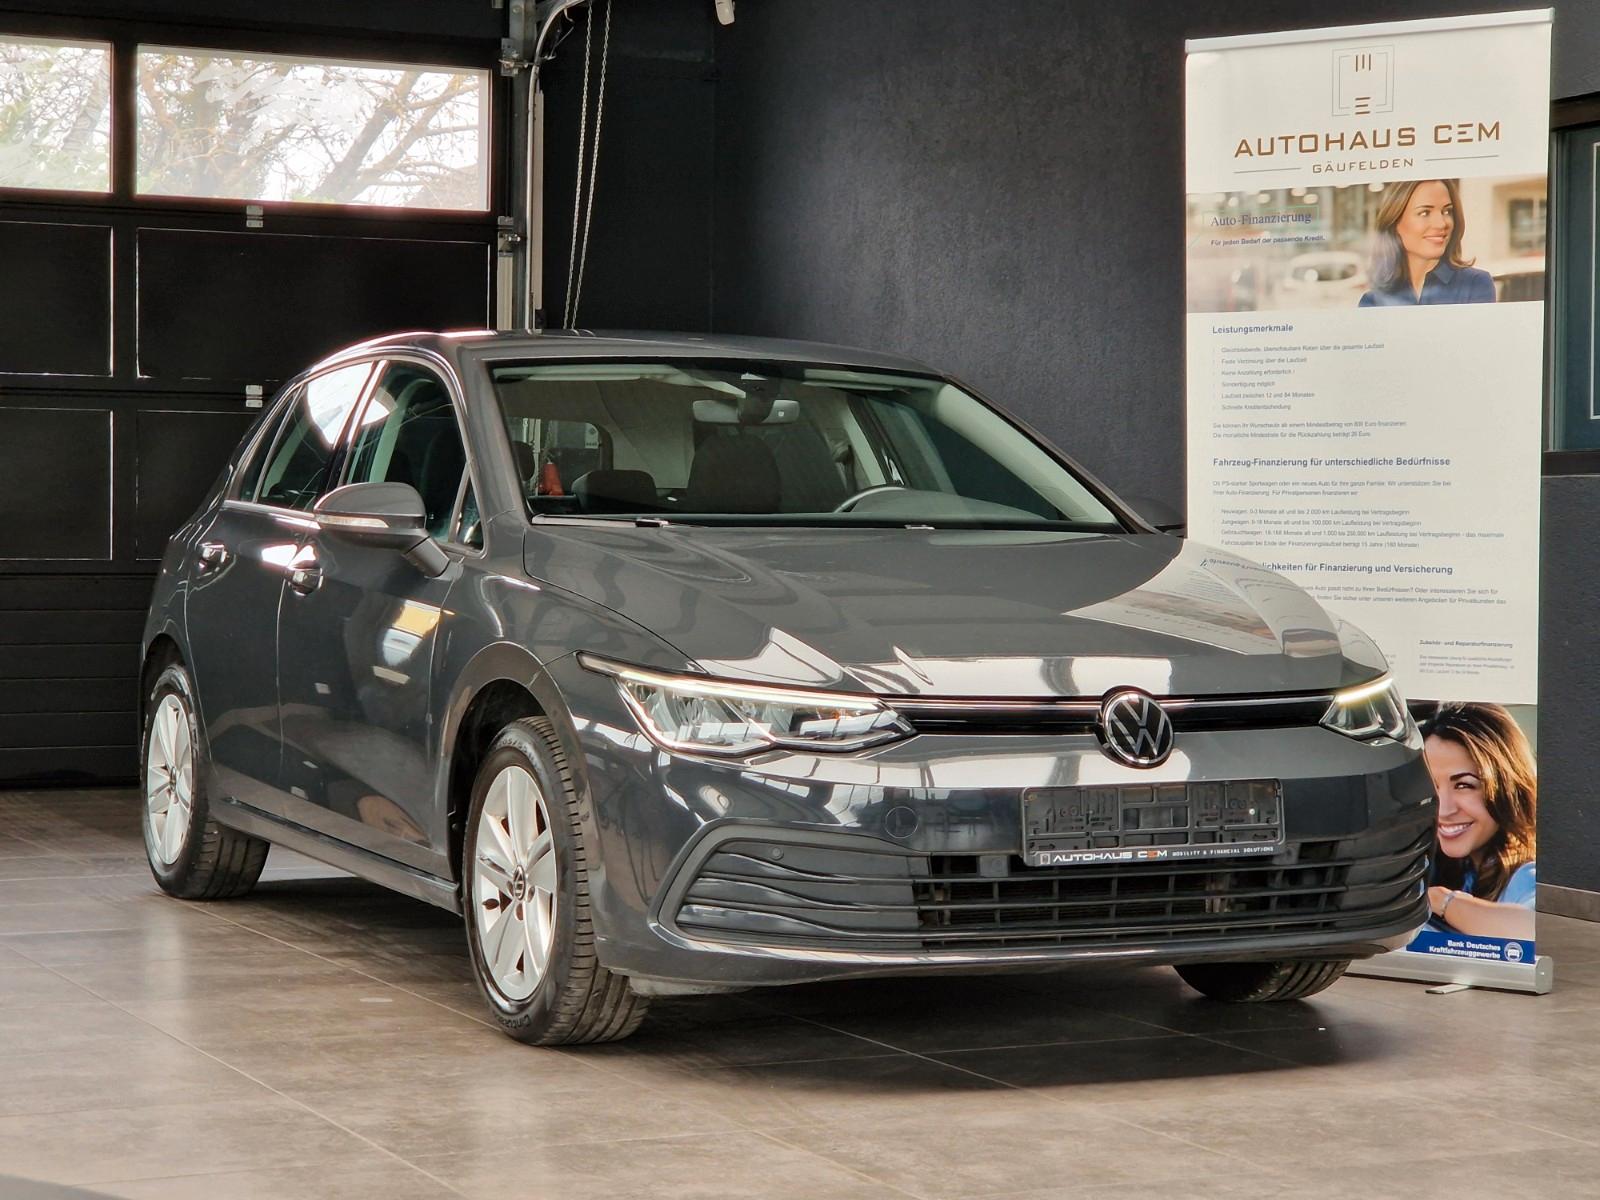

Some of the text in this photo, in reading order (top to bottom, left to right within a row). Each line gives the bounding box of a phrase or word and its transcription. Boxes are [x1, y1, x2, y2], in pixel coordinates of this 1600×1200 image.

[1234, 121, 1500, 158] AUTOHAUS CEM
[1312, 158, 1414, 174] GÄUFELDEN
[1210, 212, 1312, 227] Auto-Finanzierung
[1212, 324, 1294, 335] Leistungsmerkmale
[1213, 456, 1450, 467] Fahrzeug-Finanzierung für unterschiedliche Bedürfnisse
[1305, 562, 1317, 571] für
[1319, 562, 1373, 574] Finanzierung
[1375, 565, 1393, 573] und
[1394, 565, 1453, 576] Versicherung
[1107, 695, 1170, 760] VW
[1053, 850, 1168, 863] AUTOHAUS CEM
[1429, 945, 1501, 959] Kraftfahrzeuggewerbe
[1447, 939, 1501, 951] Bank Deutsches
